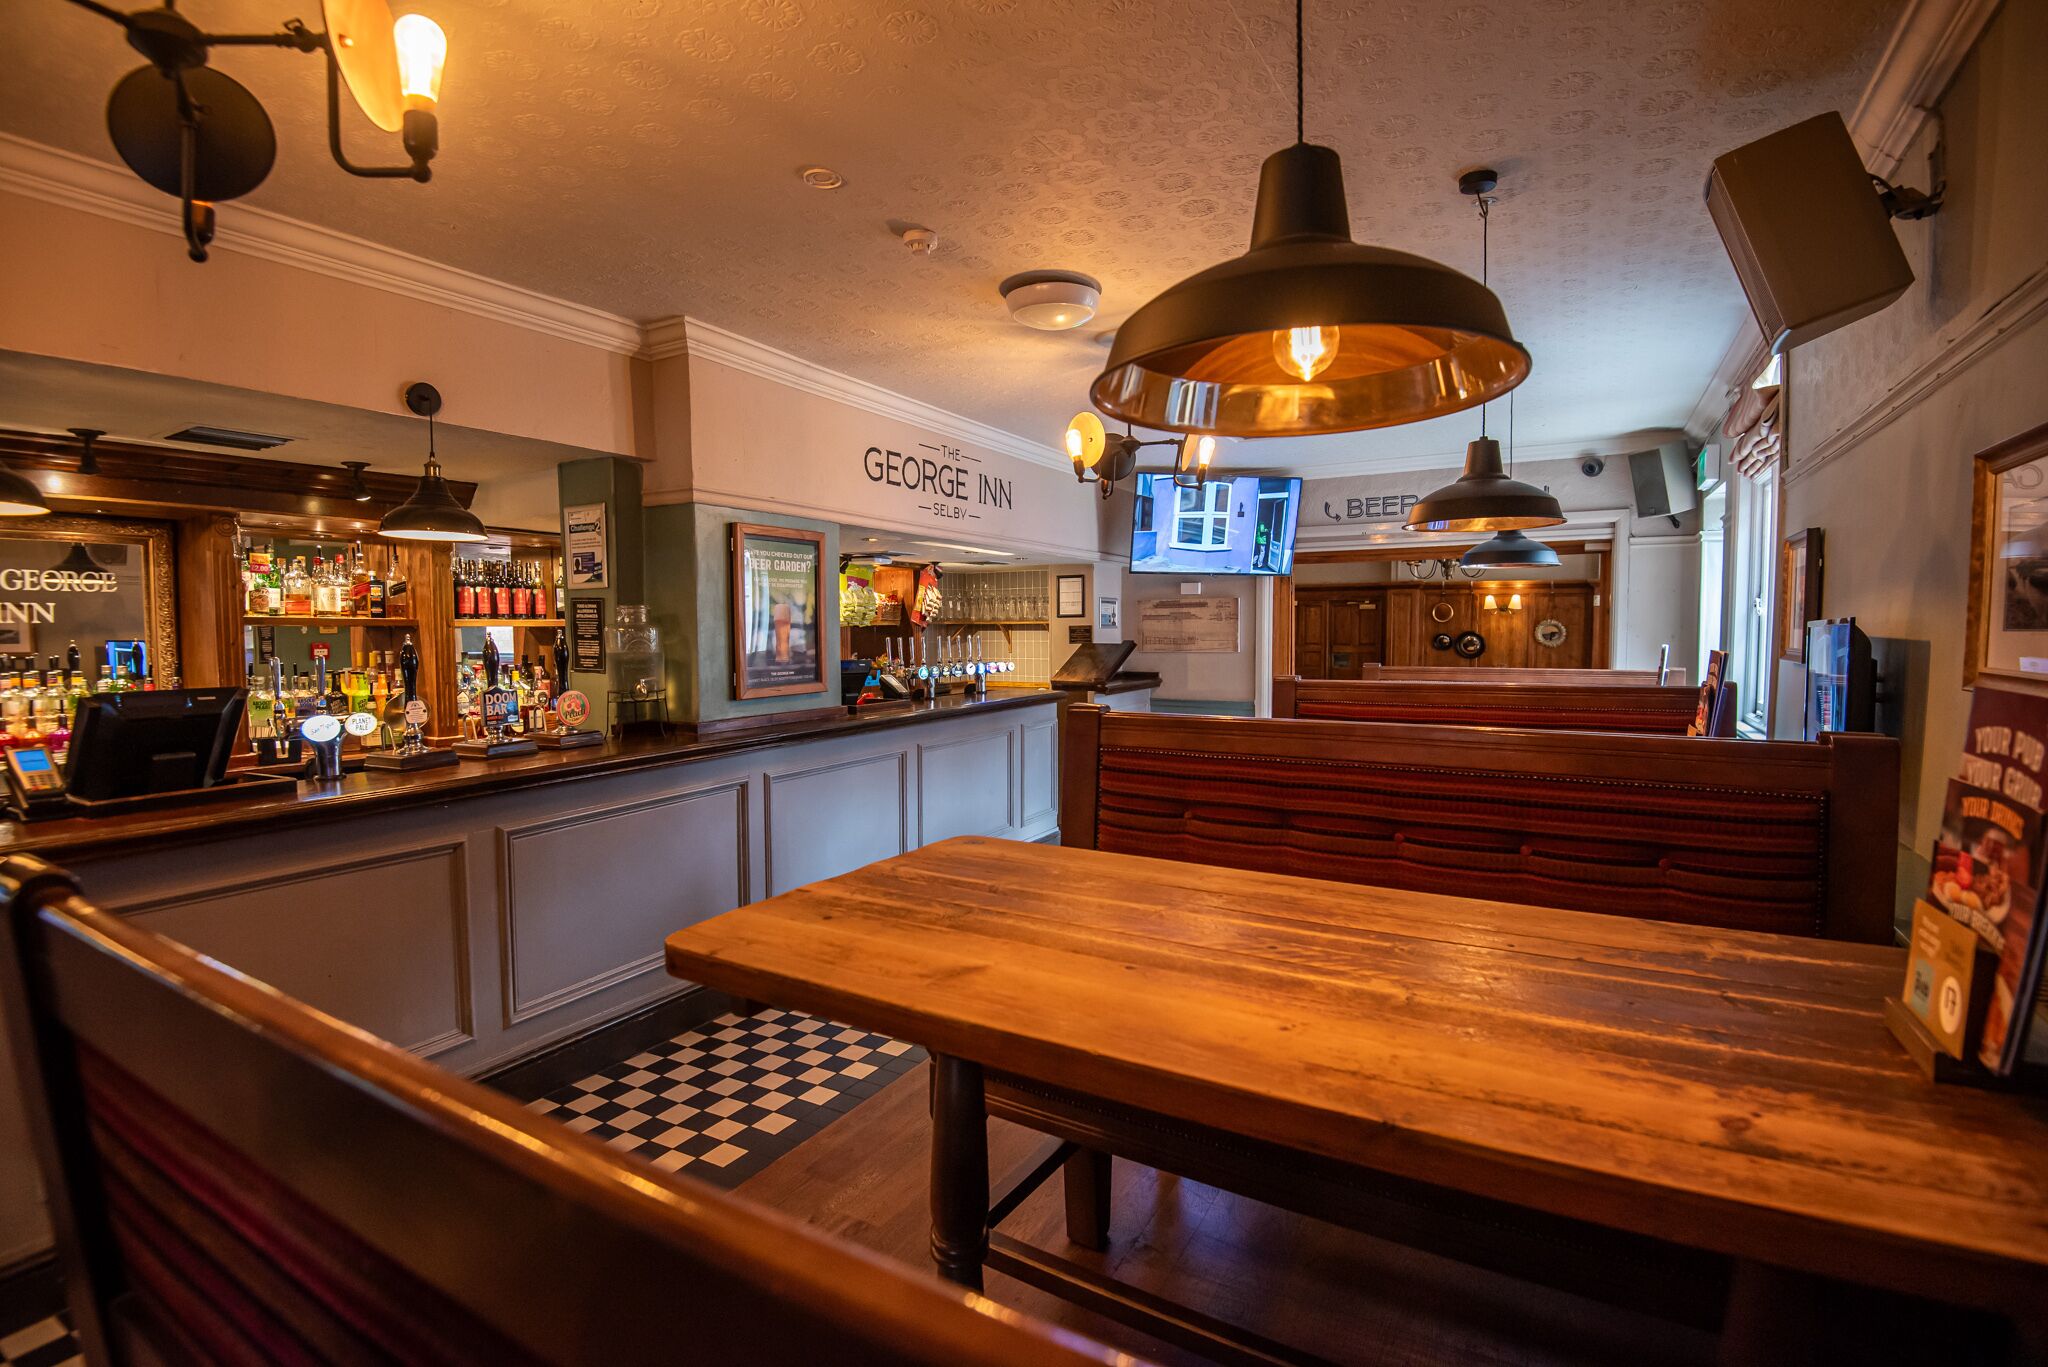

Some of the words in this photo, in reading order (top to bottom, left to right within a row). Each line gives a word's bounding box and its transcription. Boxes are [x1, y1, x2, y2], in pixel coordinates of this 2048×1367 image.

[941, 444, 961, 462] THE
[864, 446, 969, 501] GEORGE
[978, 473, 1012, 510] INN
[933, 502, 968, 520] SELBY
[750, 558, 772, 571] BEER
[774, 559, 811, 573] GARDEN?
[0, 568, 118, 593] GEORGE
[485, 691, 517, 705] DOOM
[486, 703, 508, 716] BAR
[1975, 726, 2012, 756] YOUR
[2012, 731, 2045, 773] PUB
